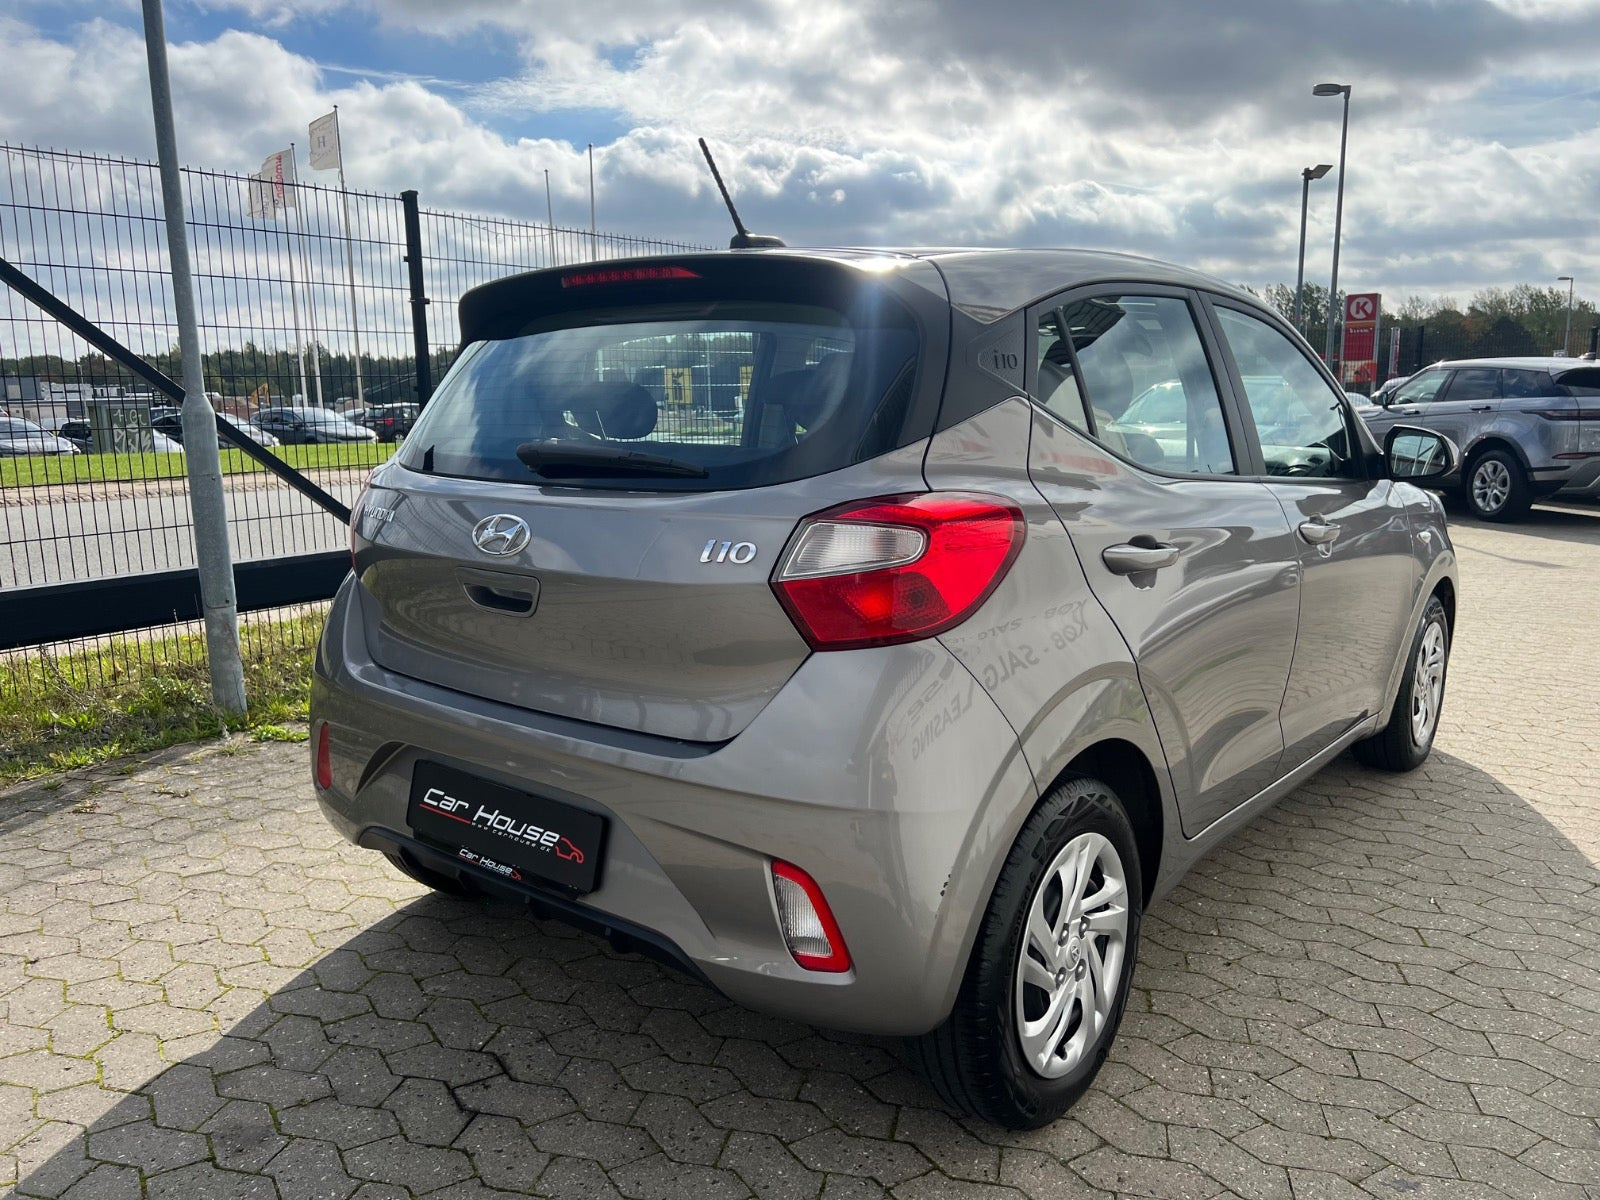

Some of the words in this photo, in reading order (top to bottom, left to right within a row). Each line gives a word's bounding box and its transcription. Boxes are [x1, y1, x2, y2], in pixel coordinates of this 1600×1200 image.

[1356, 302, 1371, 317] K
[993, 349, 1018, 370] i10
[364, 505, 395, 522] HYUNDAI
[699, 539, 757, 564] i10
[423, 787, 469, 812] Car
[472, 804, 560, 847] House
[459, 848, 479, 860] Car
[479, 856, 513, 874] House
